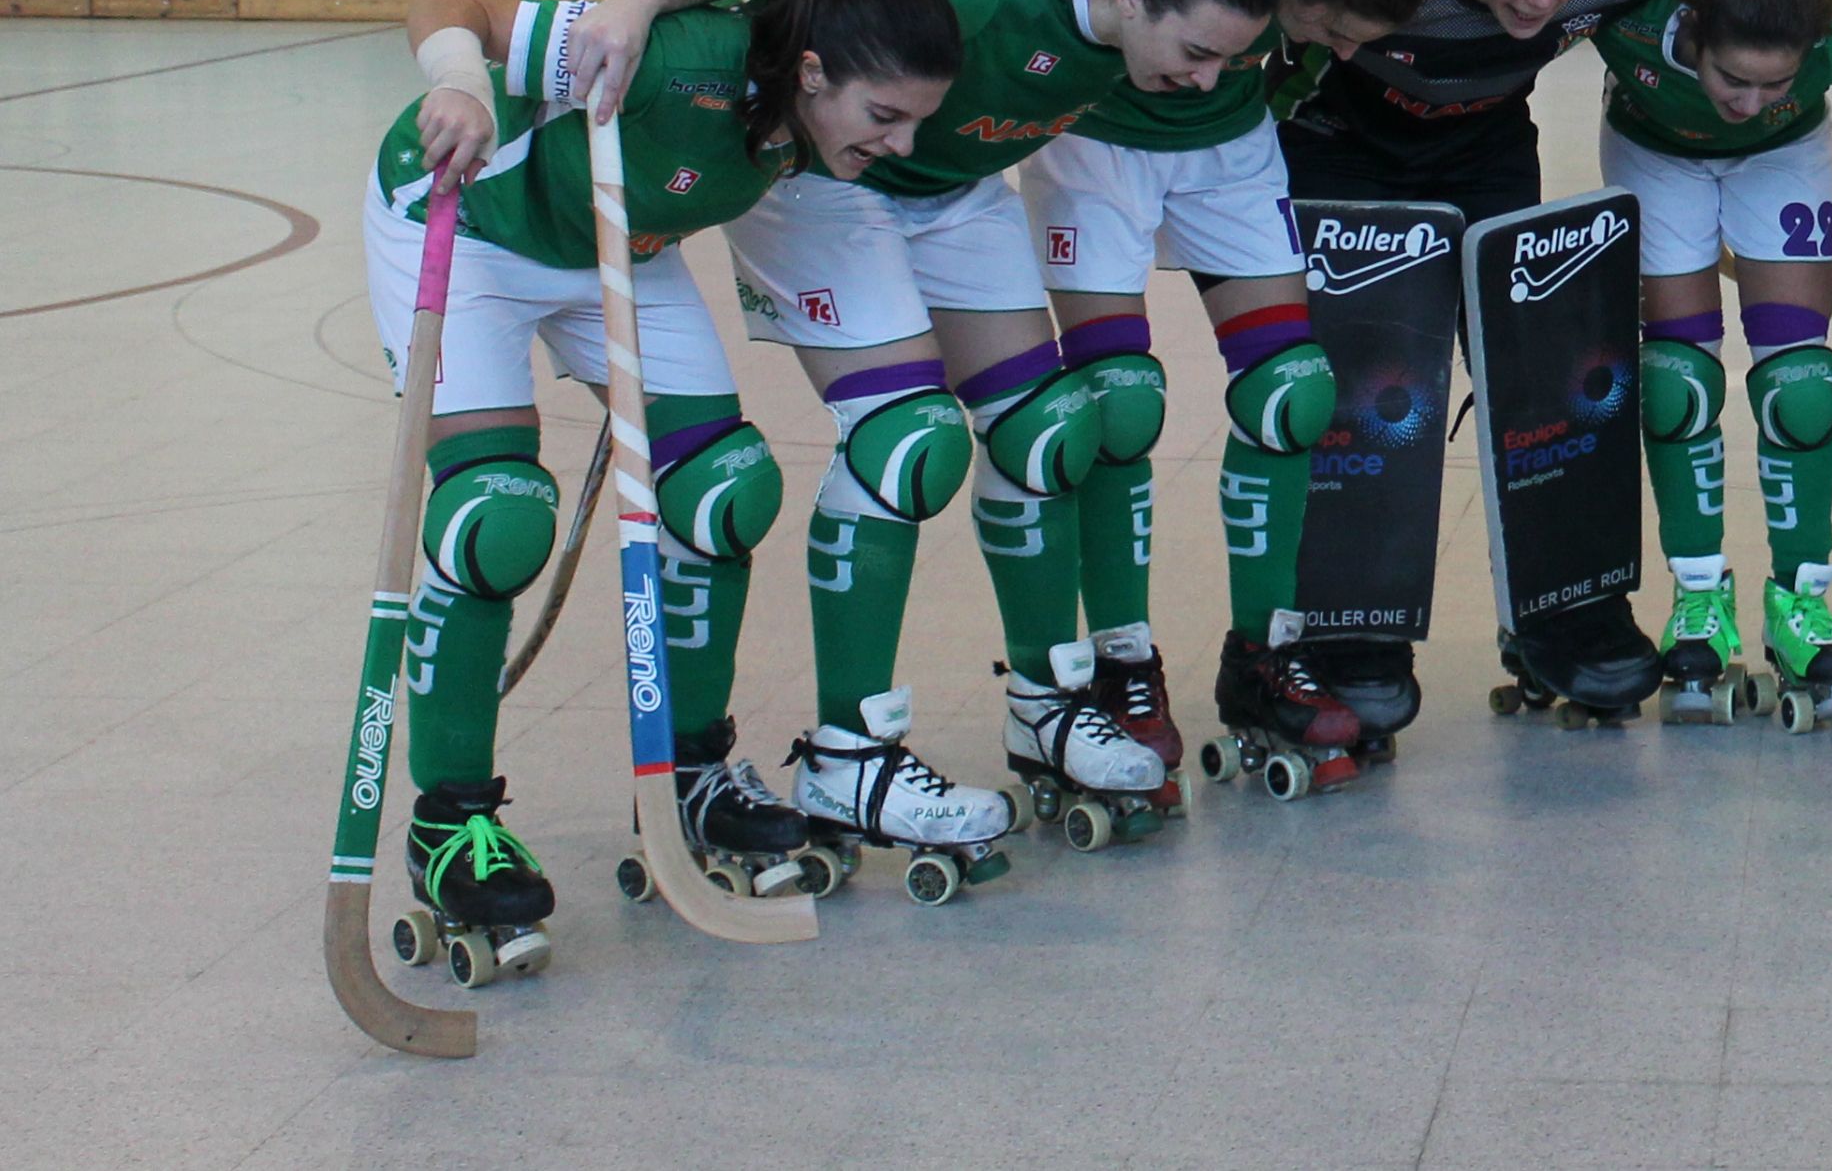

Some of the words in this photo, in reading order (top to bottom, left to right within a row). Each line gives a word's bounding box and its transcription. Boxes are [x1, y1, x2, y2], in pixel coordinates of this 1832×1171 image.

[1050, 233, 1071, 259] Tc
[804, 295, 832, 323] Tc
[1506, 432, 1598, 478] France
[1369, 609, 1407, 626] ONE
[623, 573, 663, 714] Reno
[351, 672, 399, 812] Reno
[913, 803, 968, 822] PAULA
